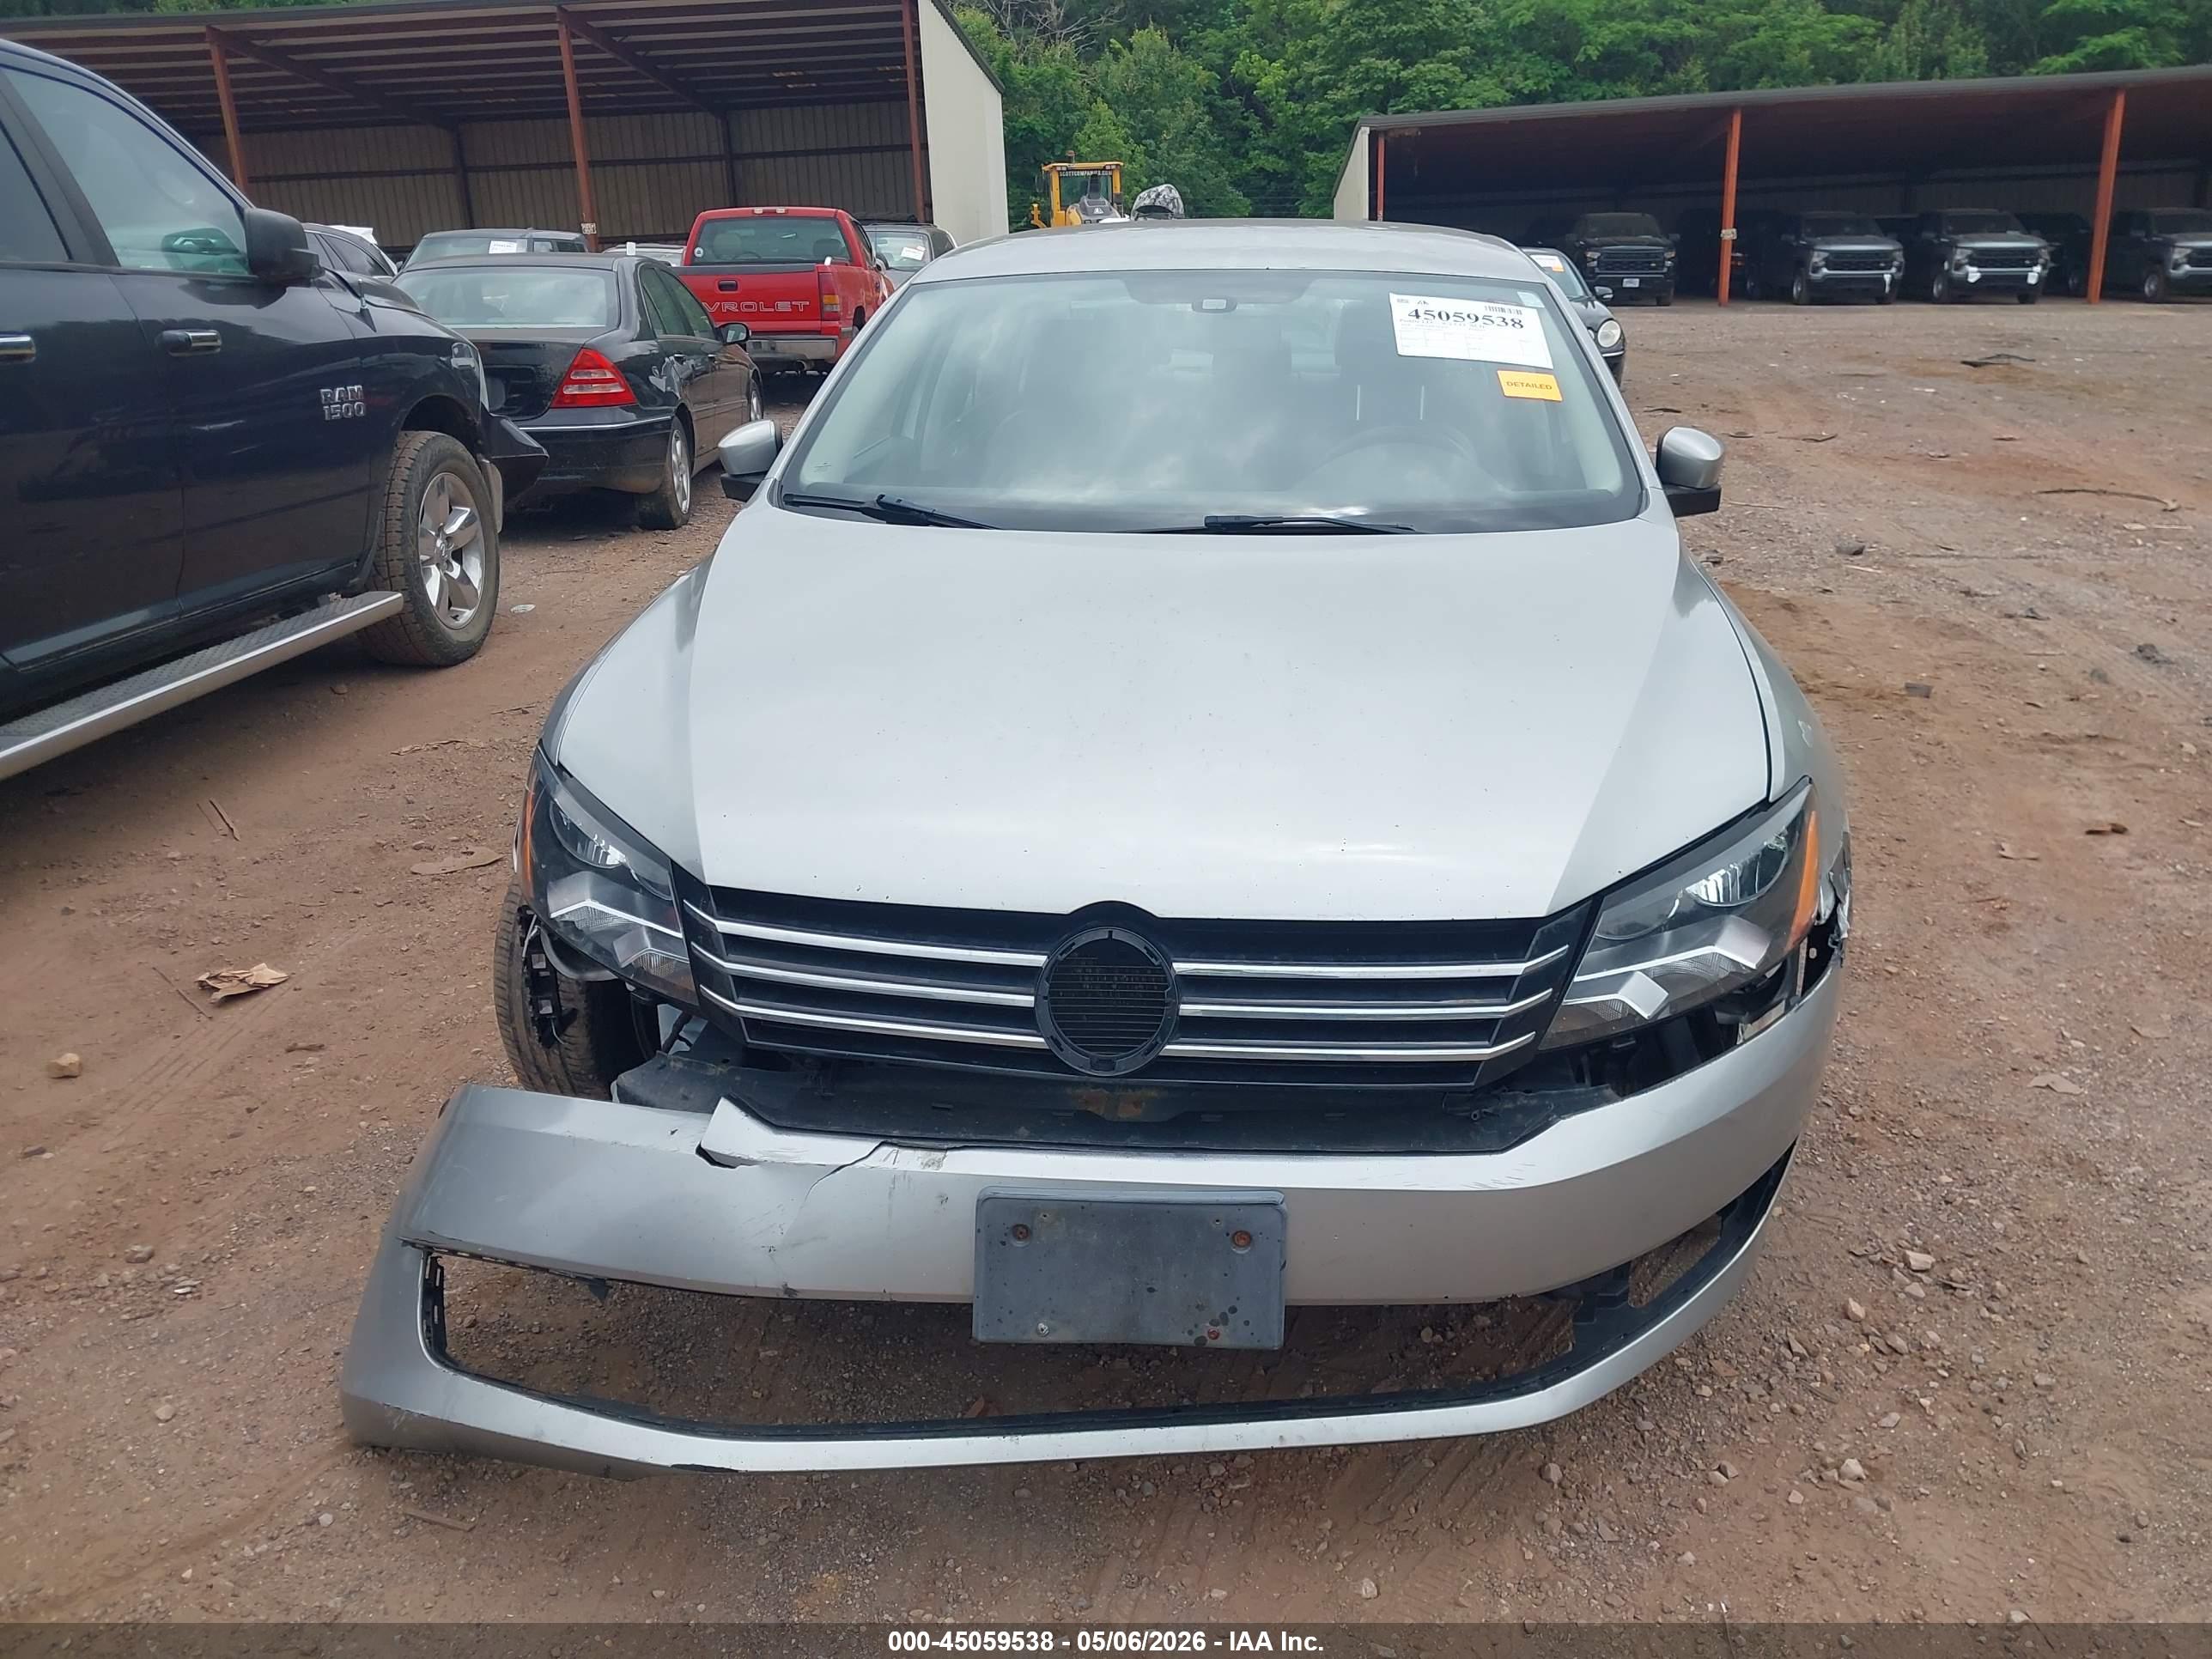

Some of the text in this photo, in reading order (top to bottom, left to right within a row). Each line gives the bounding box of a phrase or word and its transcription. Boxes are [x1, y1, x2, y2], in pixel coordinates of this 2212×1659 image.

[702, 301, 810, 313] VROLET
[1407, 308, 1524, 330] 45059538
[320, 385, 363, 404] RAM
[1506, 380, 1553, 390] DETAILED
[323, 402, 365, 421] 1500
